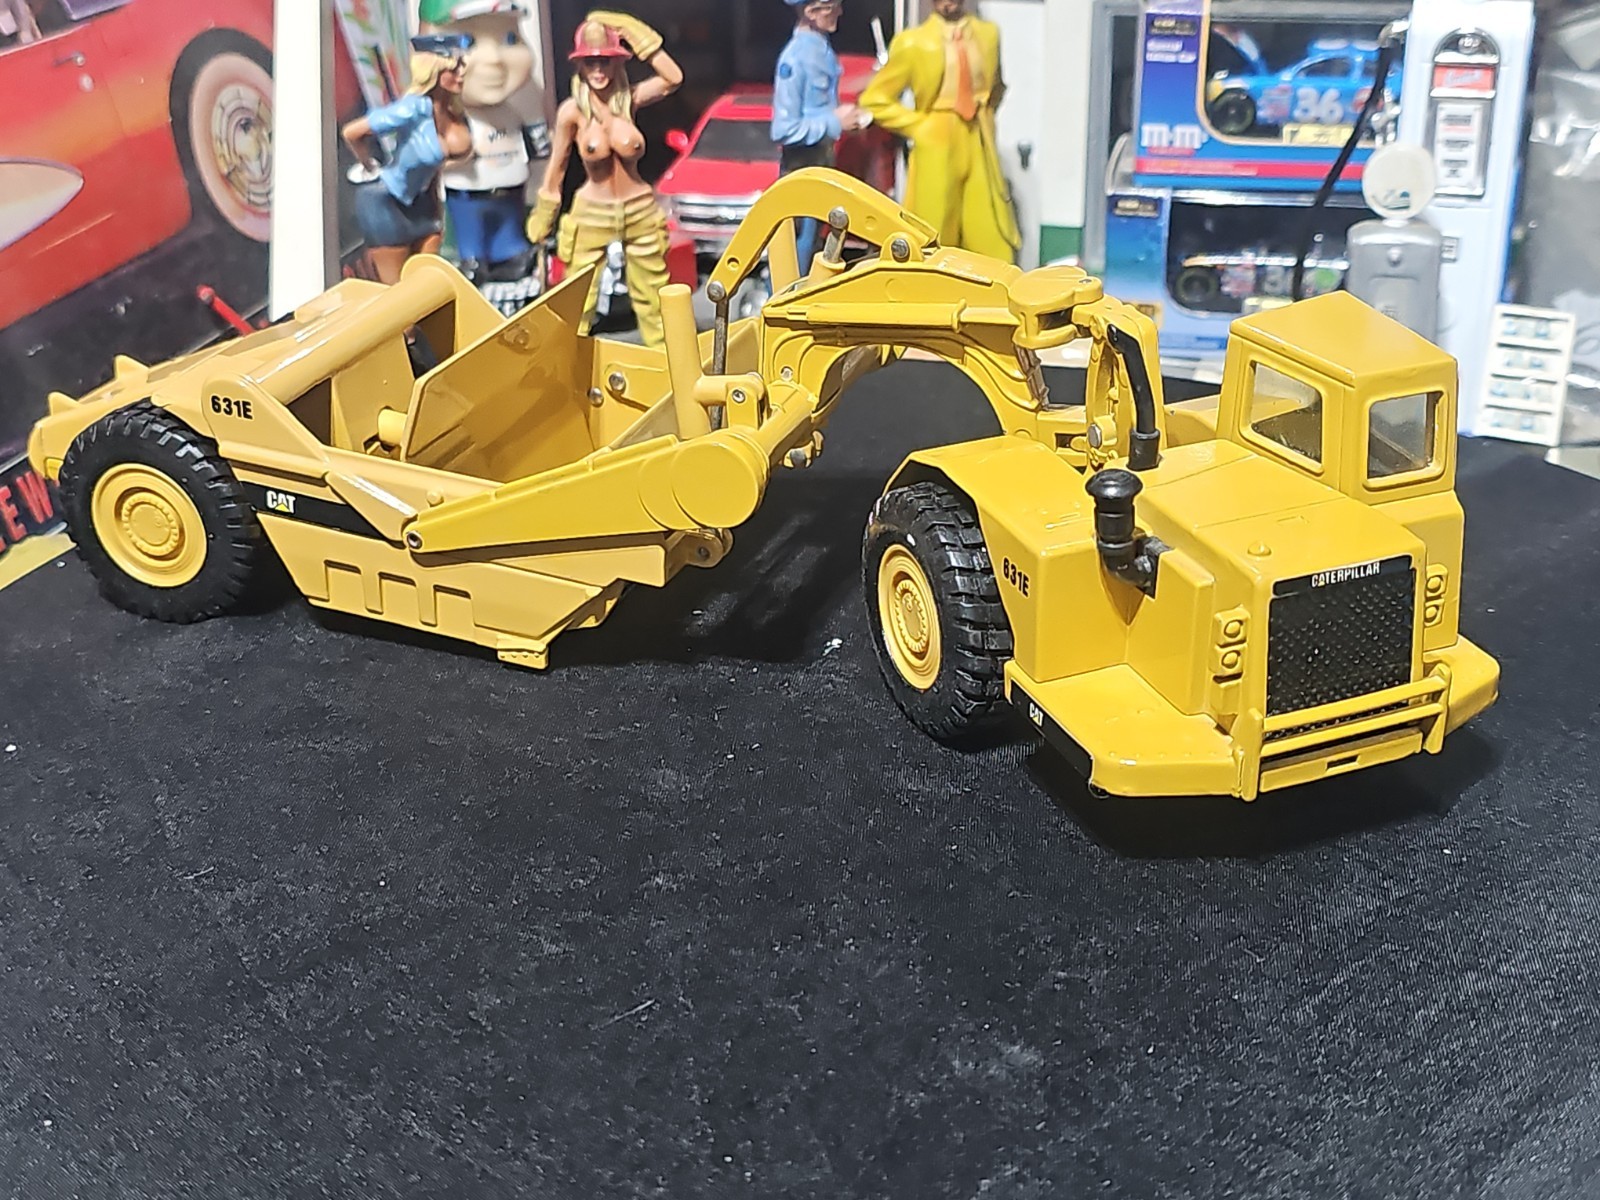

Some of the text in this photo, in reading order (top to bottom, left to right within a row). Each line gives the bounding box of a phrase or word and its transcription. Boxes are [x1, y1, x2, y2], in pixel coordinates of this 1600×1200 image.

[1294, 86, 1344, 124] 36
[211, 395, 254, 420] 631E
[0, 470, 54, 553] EW
[266, 490, 296, 514] CAT
[1003, 557, 1030, 598] 631E
[1311, 561, 1380, 588] CATERPILLAR
[1029, 702, 1044, 727] CAT
